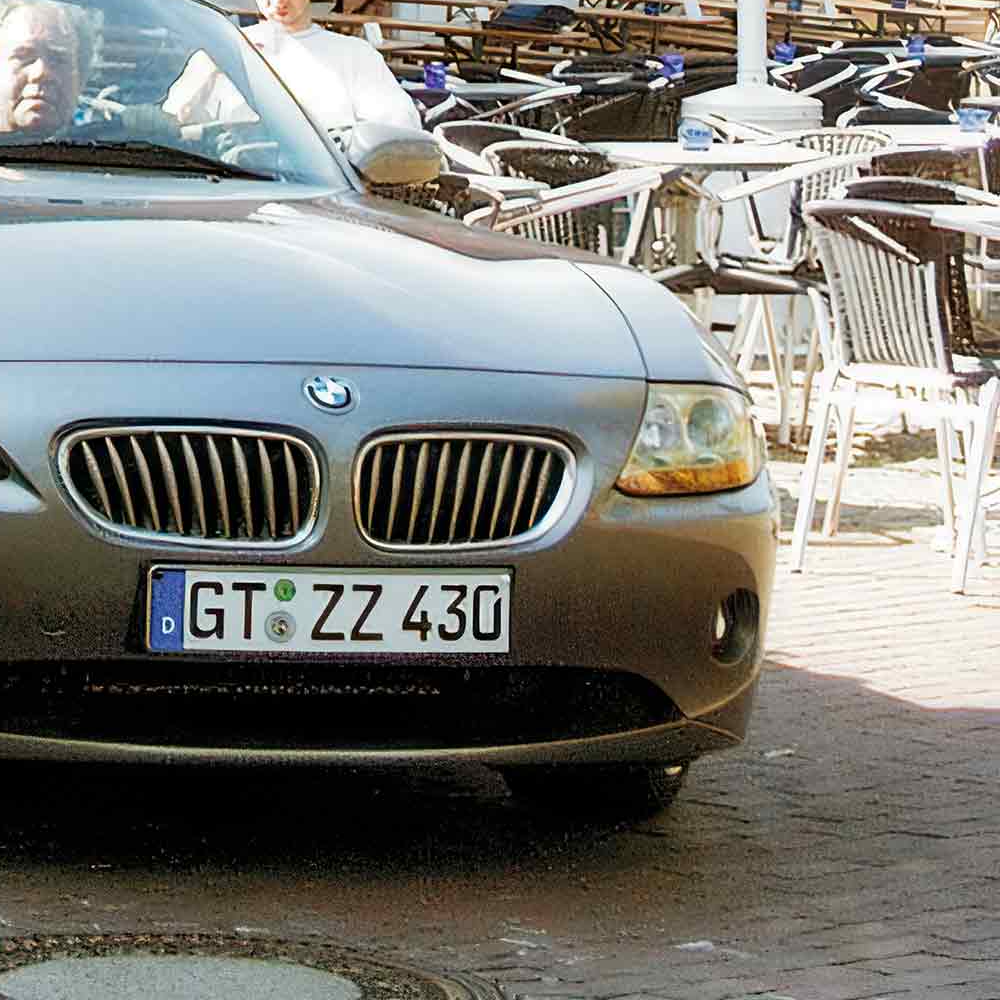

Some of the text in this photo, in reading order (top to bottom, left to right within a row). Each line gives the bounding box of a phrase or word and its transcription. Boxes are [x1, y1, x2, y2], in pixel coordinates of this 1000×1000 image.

[161, 616, 175, 634] D
[189, 580, 503, 642] GT ZZ 430
